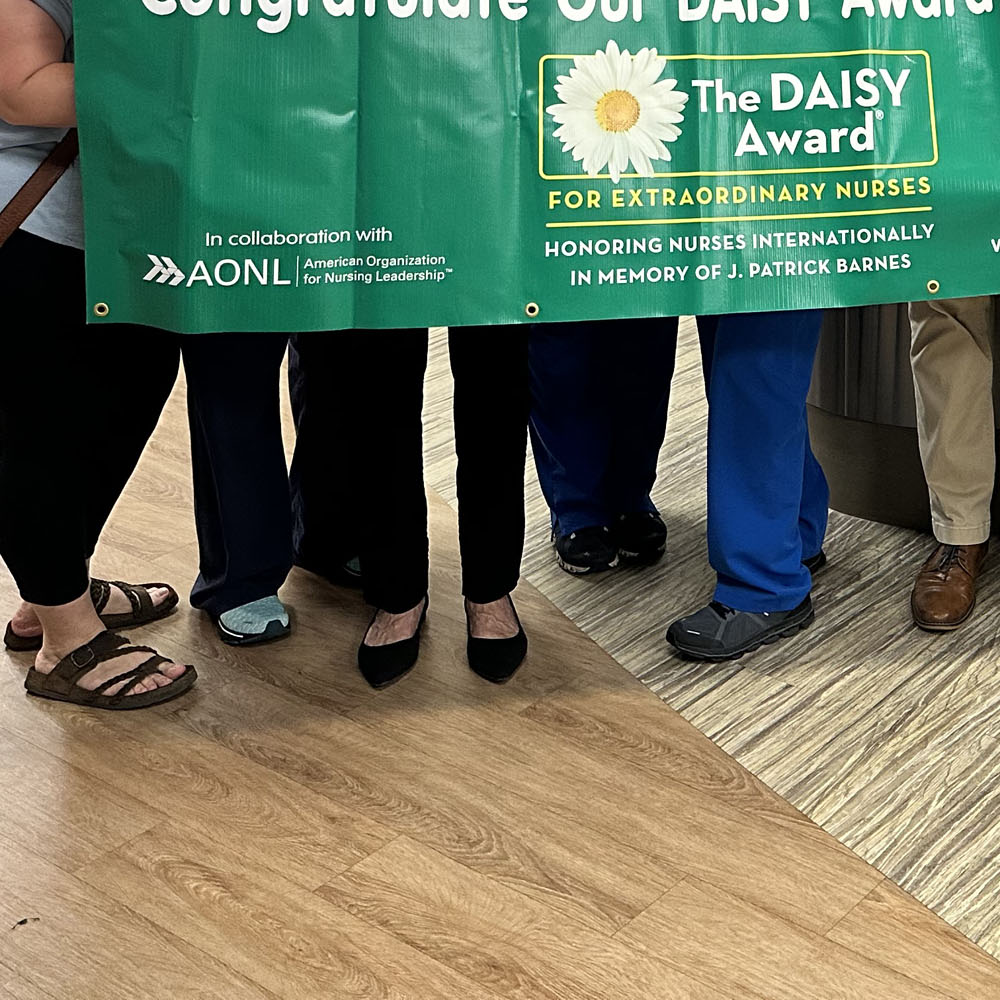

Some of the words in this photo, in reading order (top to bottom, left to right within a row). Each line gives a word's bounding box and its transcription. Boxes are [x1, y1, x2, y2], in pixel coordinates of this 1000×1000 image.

[691, 78, 761, 113] The
[770, 67, 911, 112] DAISY
[548, 189, 601, 210] FOR
[612, 182, 827, 208] EXTRAORDINARY
[836, 176, 932, 200] NURSES
[205, 231, 223, 247] In
[228, 227, 351, 246] collaboration
[355, 226, 393, 242] with
[544, 237, 663, 257] HONORING
[669, 234, 746, 253] NURSES
[752, 223, 935, 250] INTERNATIONALLY
[185, 258, 292, 288] AONL
[303, 256, 364, 270] American
[366, 254, 446, 269] Organization
[303, 273, 322, 285] for
[324, 270, 373, 284] Nursing
[570, 269, 592, 286] IN
[597, 265, 690, 285] MEMORY
[695, 264, 722, 281] OF
[727, 263, 744, 279] J.
[749, 259, 832, 278] PATRICK
[836, 253, 912, 274] BARNES
